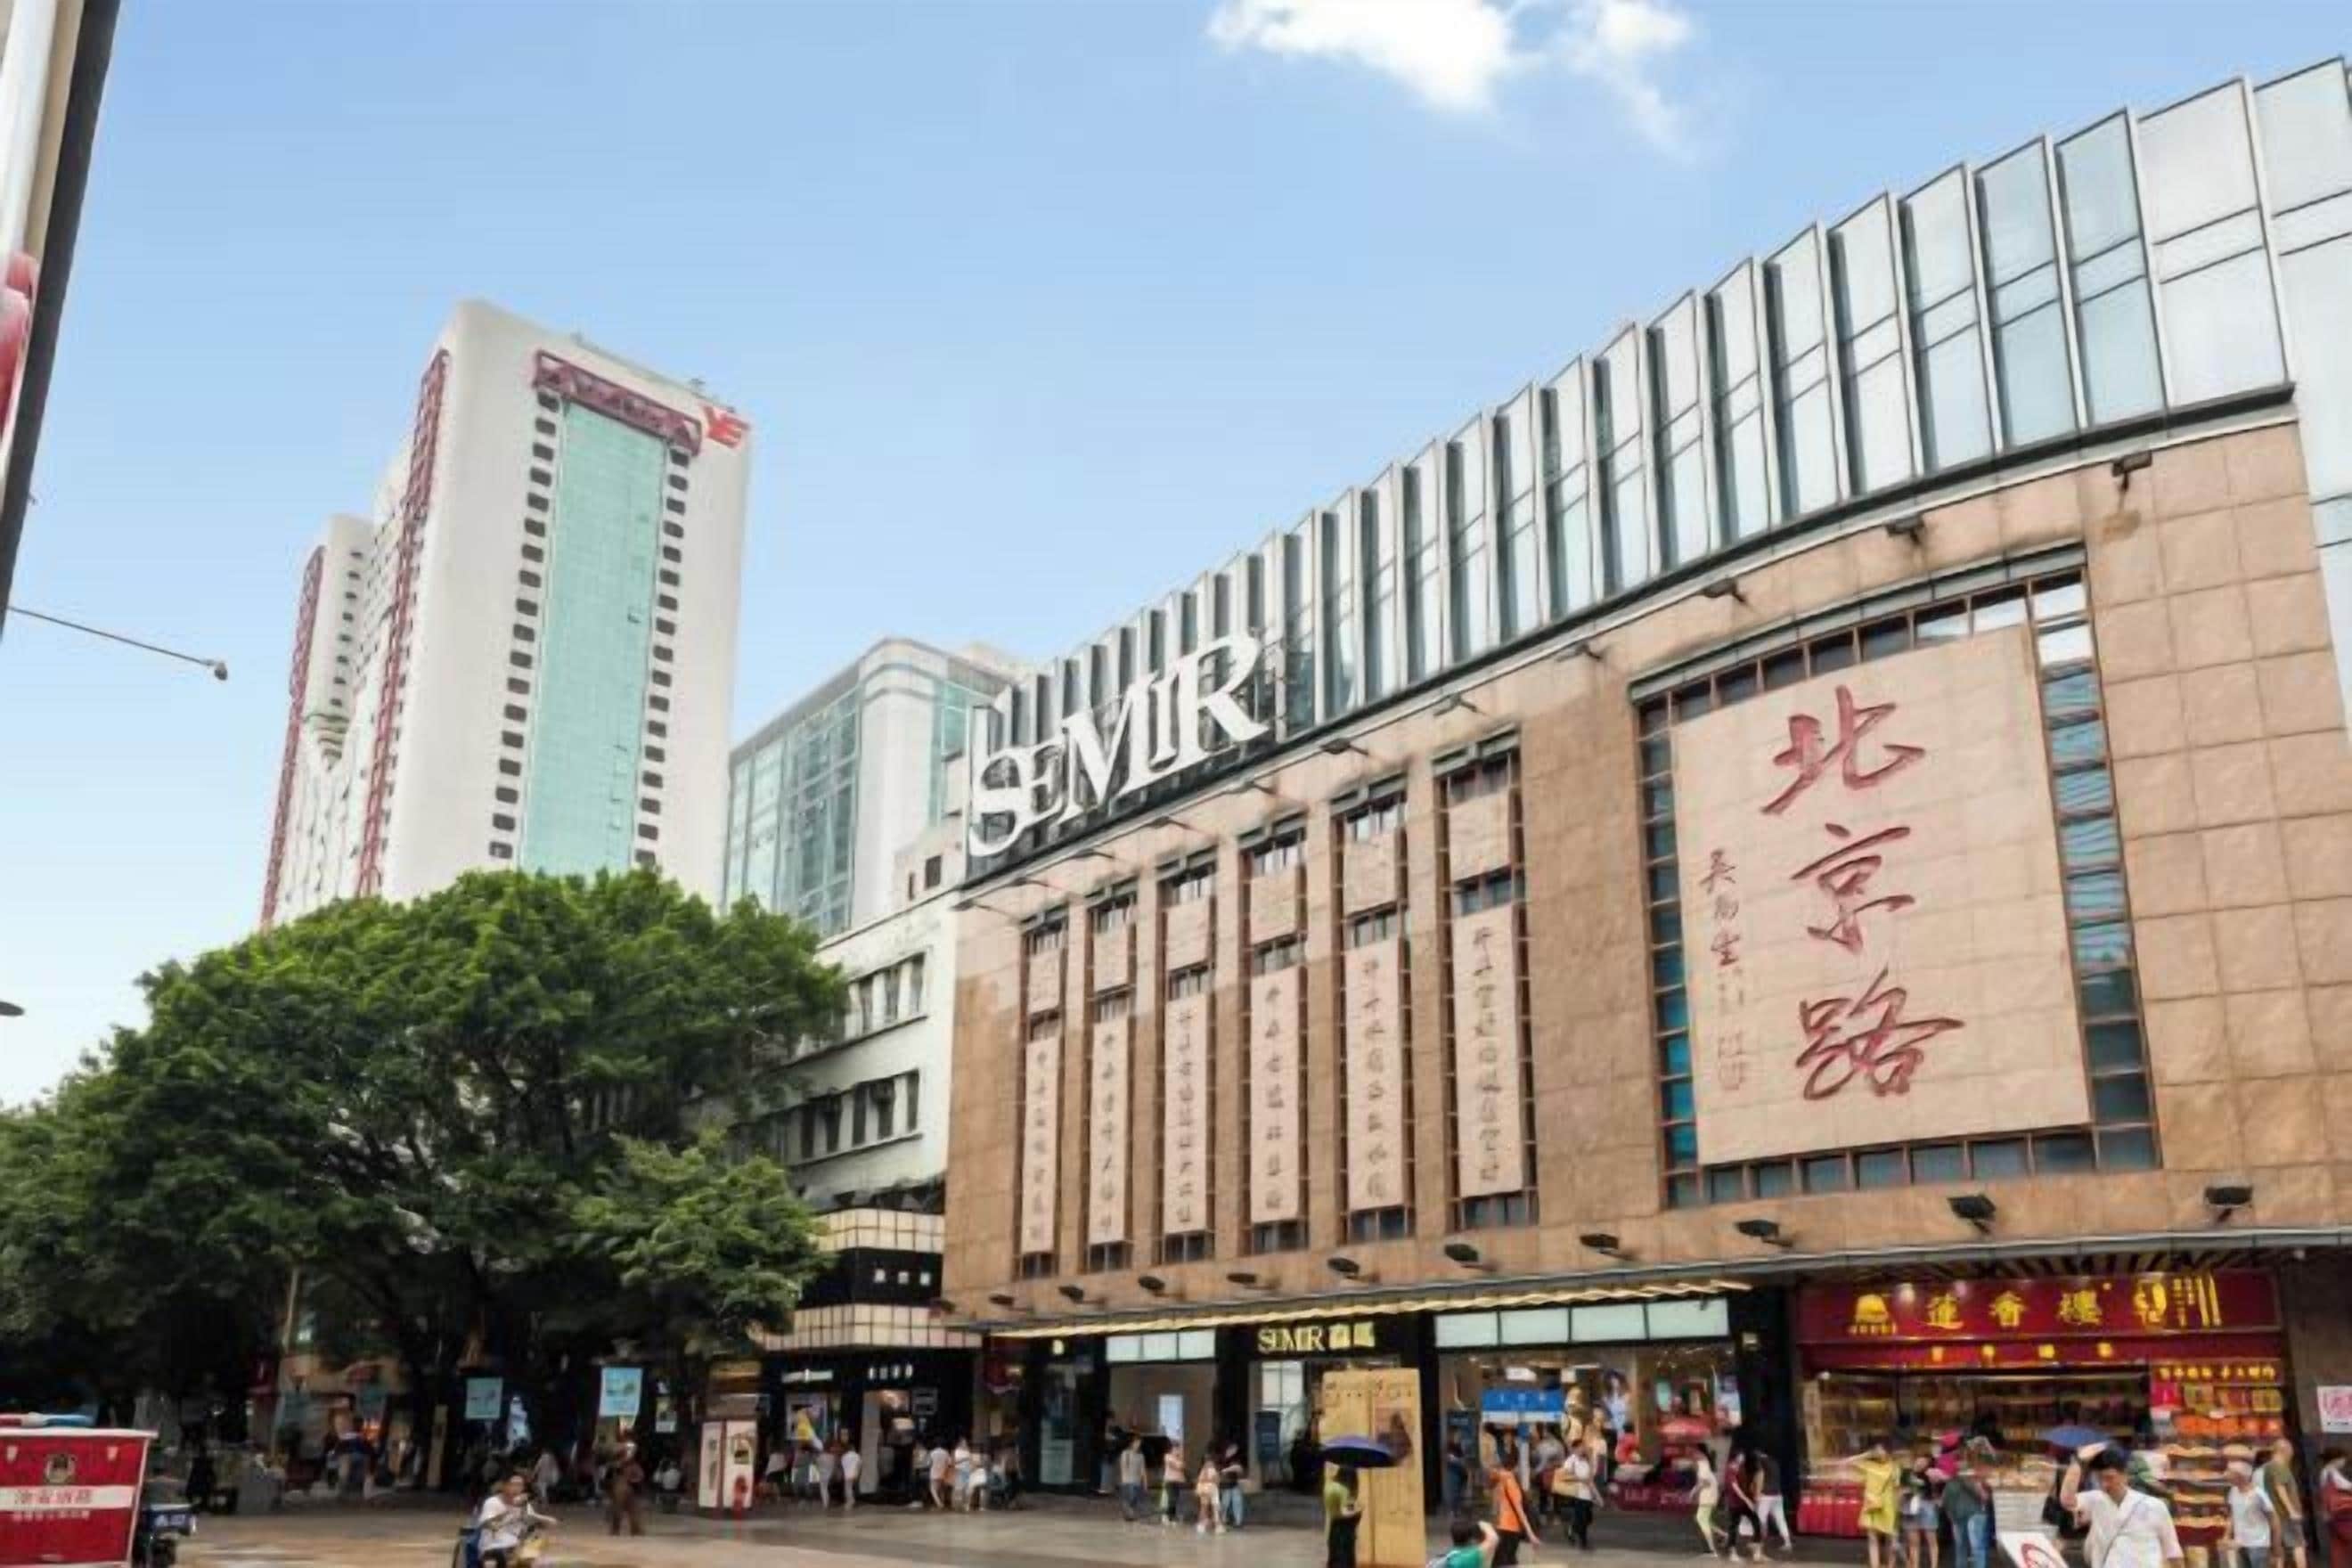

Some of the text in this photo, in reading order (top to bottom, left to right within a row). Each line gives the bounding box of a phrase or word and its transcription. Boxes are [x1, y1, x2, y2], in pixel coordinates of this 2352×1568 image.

[968, 634, 1270, 857] SEMIR
[1760, 683, 1965, 1101] 北京路
